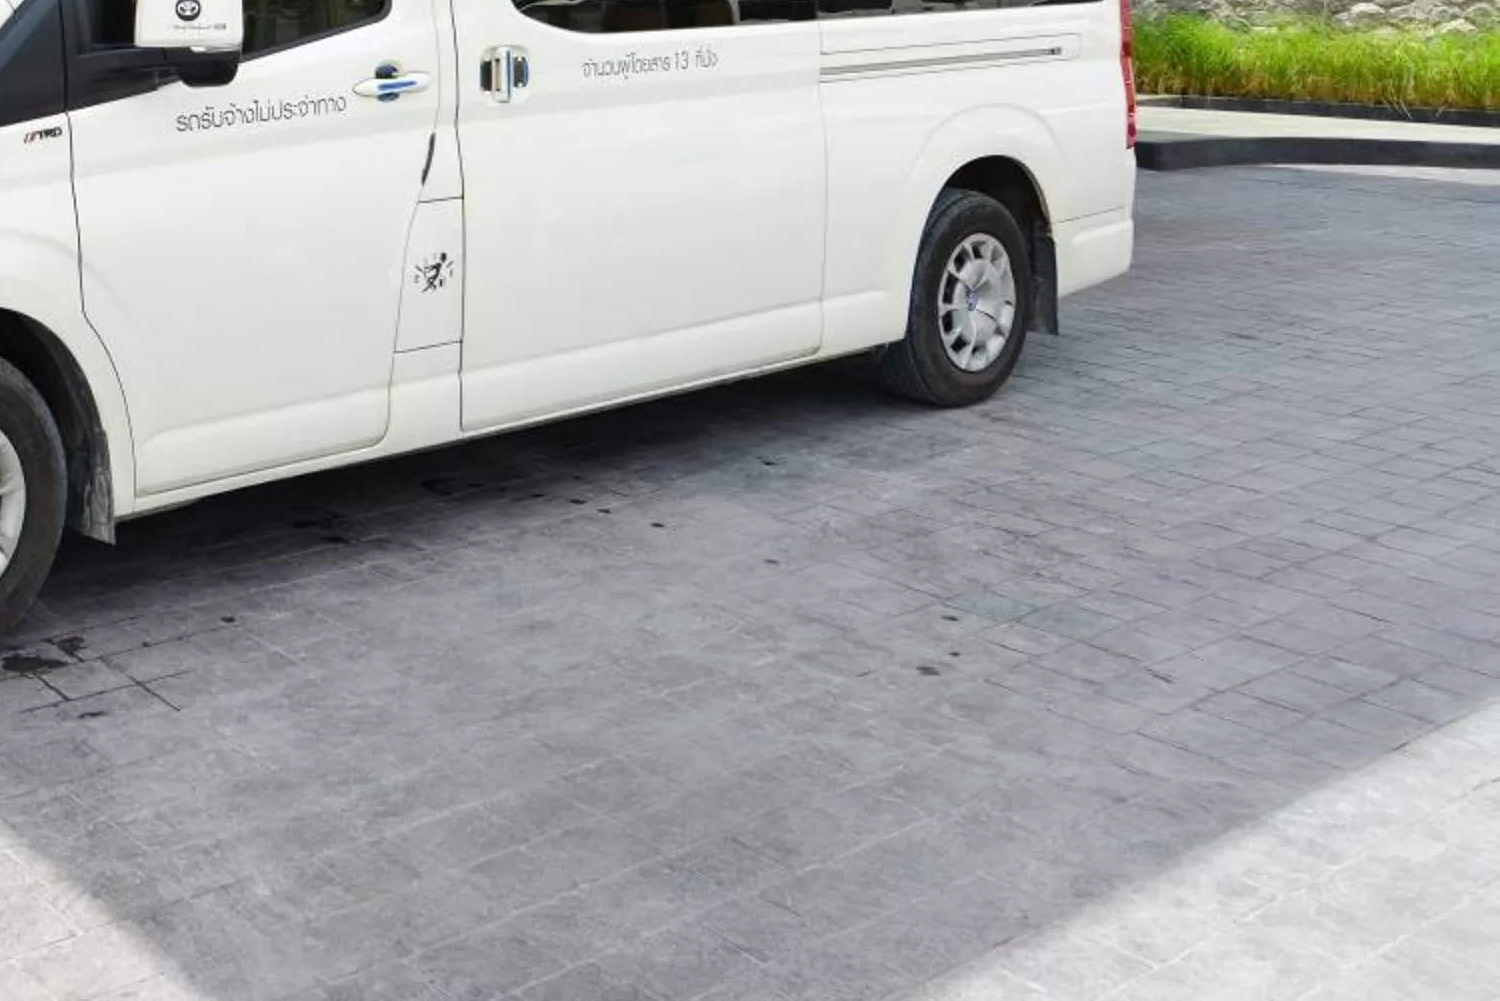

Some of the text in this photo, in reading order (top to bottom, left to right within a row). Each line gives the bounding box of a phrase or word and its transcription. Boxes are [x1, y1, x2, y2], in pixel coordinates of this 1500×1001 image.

[675, 50, 689, 70] 13
[176, 95, 347, 132] รถรับจ้างไม่ประจำทาง
